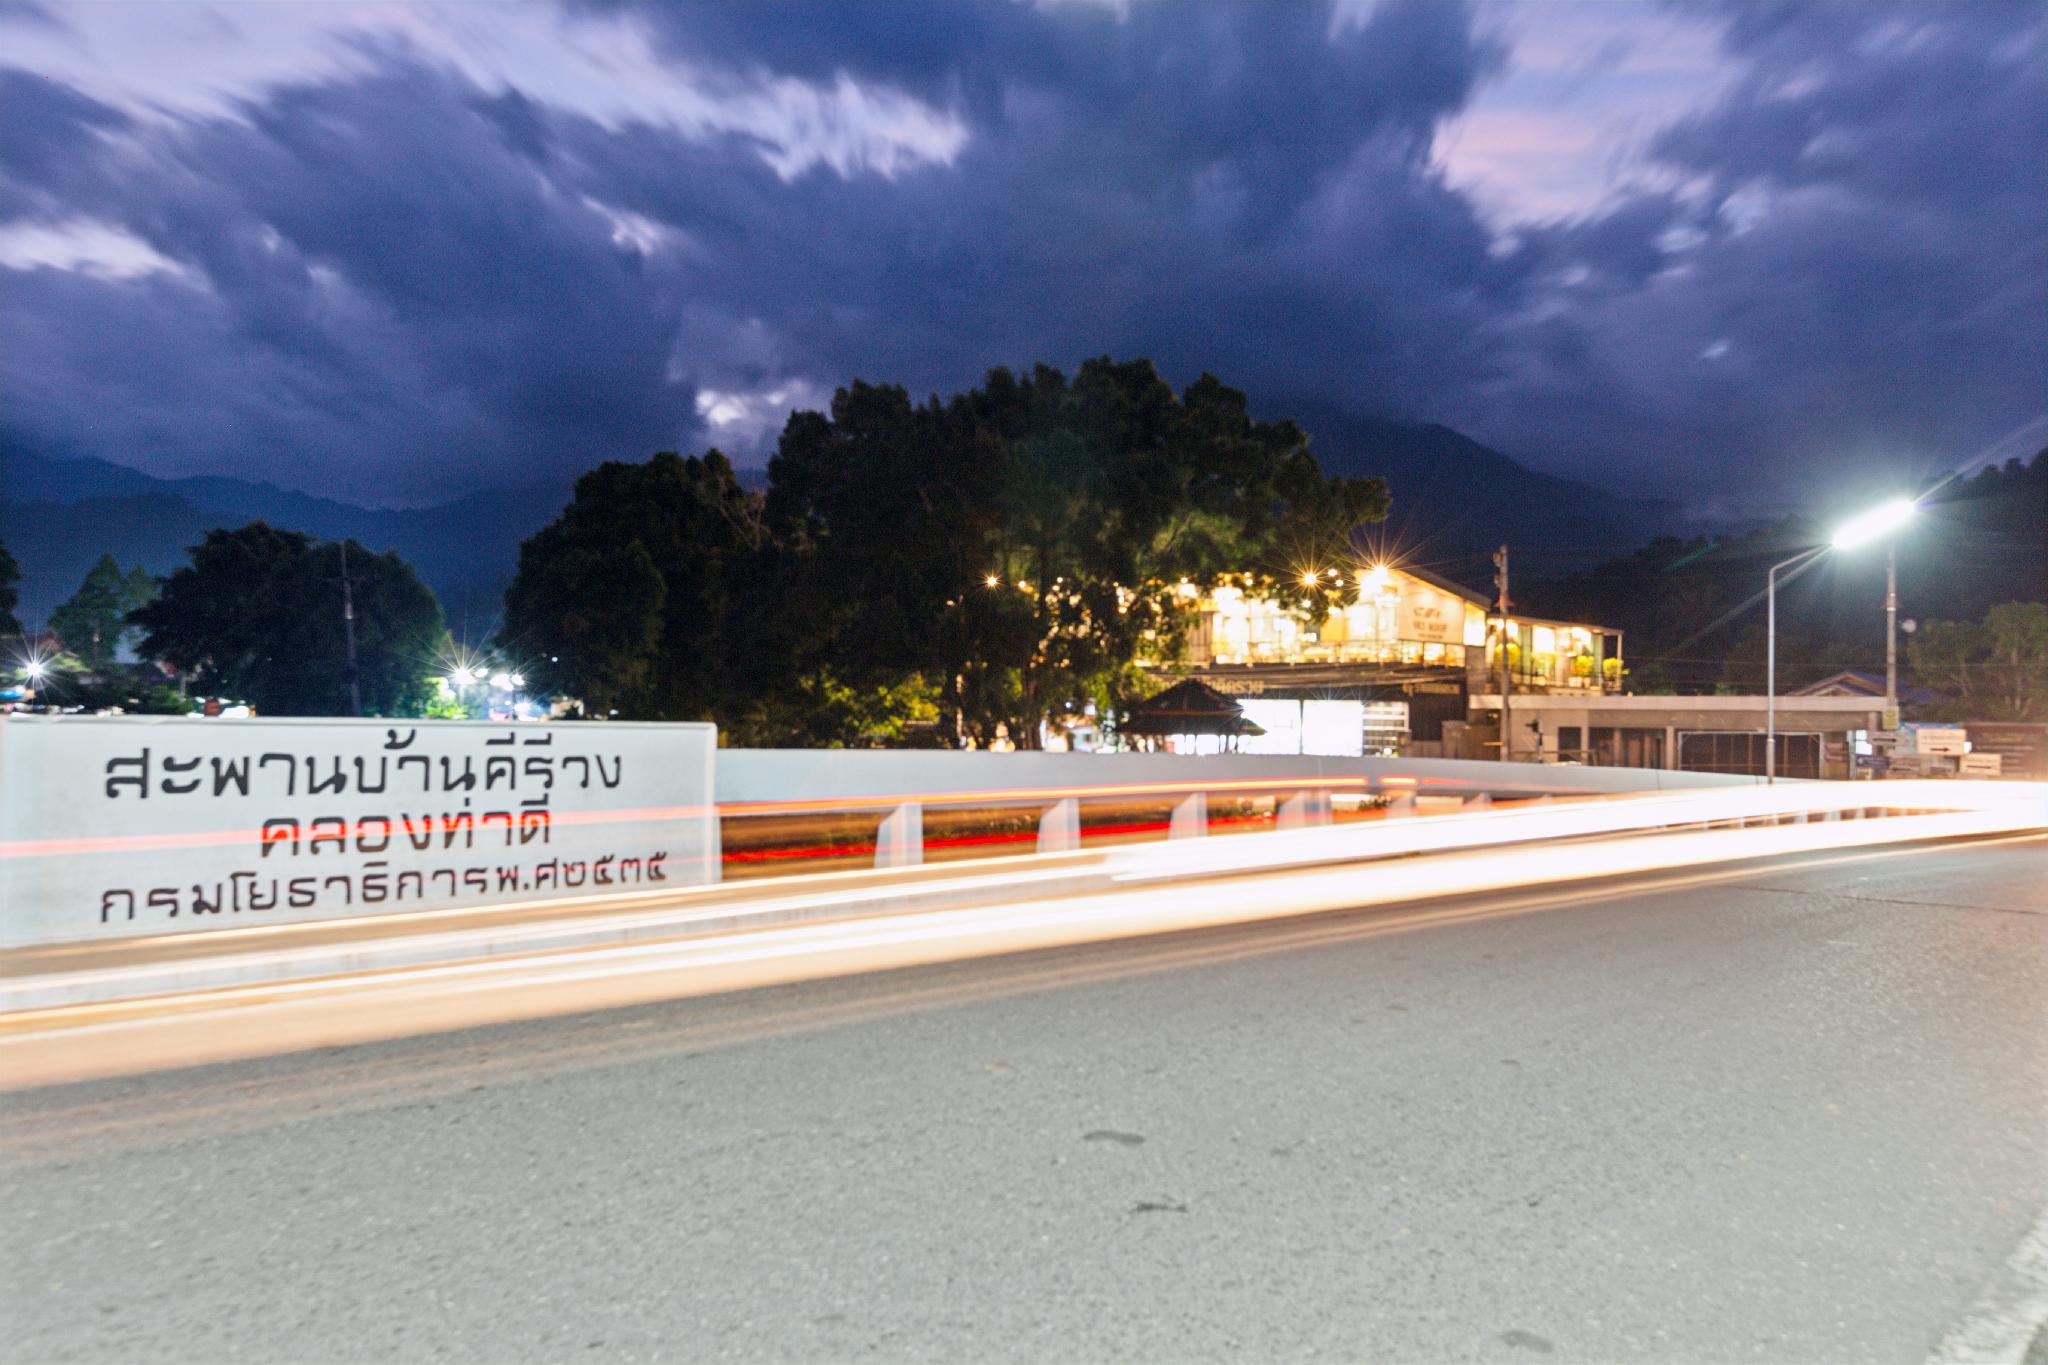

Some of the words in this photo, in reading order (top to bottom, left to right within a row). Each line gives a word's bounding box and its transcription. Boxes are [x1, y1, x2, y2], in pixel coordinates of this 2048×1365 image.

[103, 729, 623, 801] สะพานบ้านคีรีวง
[260, 791, 553, 860] คลองท่าดี
